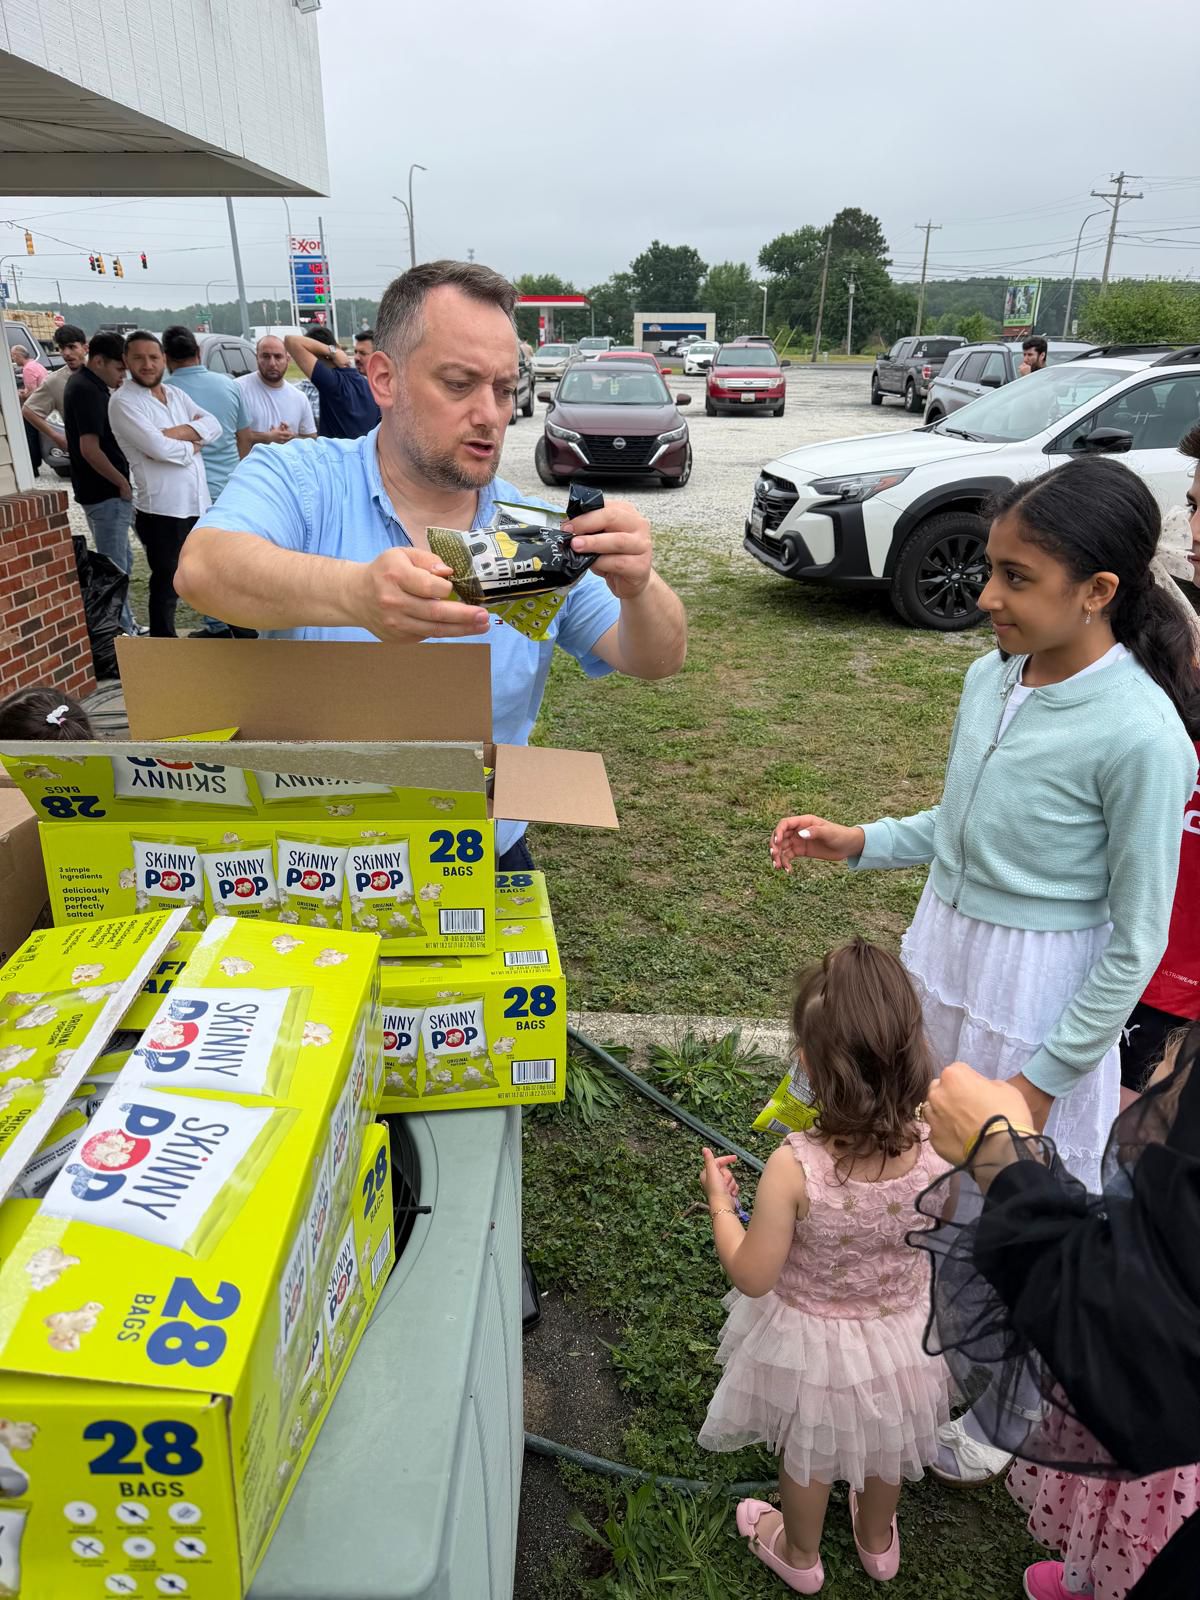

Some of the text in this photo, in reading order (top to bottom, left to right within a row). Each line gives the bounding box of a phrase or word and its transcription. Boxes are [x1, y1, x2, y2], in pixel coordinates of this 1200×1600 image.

[44, 786, 81, 794] BAGS
[131, 768, 227, 794] SKiNNY
[40, 795, 107, 819] 28
[429, 829, 484, 863] 28
[65, 866, 91, 874] simple
[145, 851, 196, 871] SKiNNY
[215, 858, 265, 878] SKiNNY
[289, 850, 339, 871] SKiNNY
[353, 852, 401, 871] SKiNNY
[442, 866, 473, 876] BAGS
[59, 873, 103, 881] ingredients
[145, 869, 196, 892] POP
[218, 876, 269, 899] POP
[286, 868, 336, 892] POP
[355, 870, 404, 892] POP
[495, 873, 534, 888] 28
[62, 886, 110, 896] deliciously
[63, 895, 101, 903] popped,
[65, 903, 105, 912] perfectly
[297, 901, 320, 909] ORIGINAL
[503, 985, 557, 1018] 28
[54, 1013, 84, 1048] ORIGINAL
[430, 1010, 476, 1030] SKiNNY
[516, 1020, 546, 1031] BAGS
[134, 999, 209, 1073] POP
[194, 1001, 260, 1077] SKiNNY
[383, 1031, 412, 1050] OP
[432, 1027, 479, 1049] POP
[447, 1057, 469, 1065] ORIGINAL
[65, 1103, 176, 1202] POP
[122, 1117, 229, 1221] SKiNNY
[362, 1145, 387, 1219] 28
[370, 1189, 385, 1223] BAGS
[328, 1237, 351, 1300] SKiNNY
[330, 1258, 354, 1322] POP
[117, 1293, 157, 1343] BAGS
[146, 1276, 241, 1368] 28
[82, 1419, 204, 1477] 28
[119, 1481, 185, 1498] BAGS
